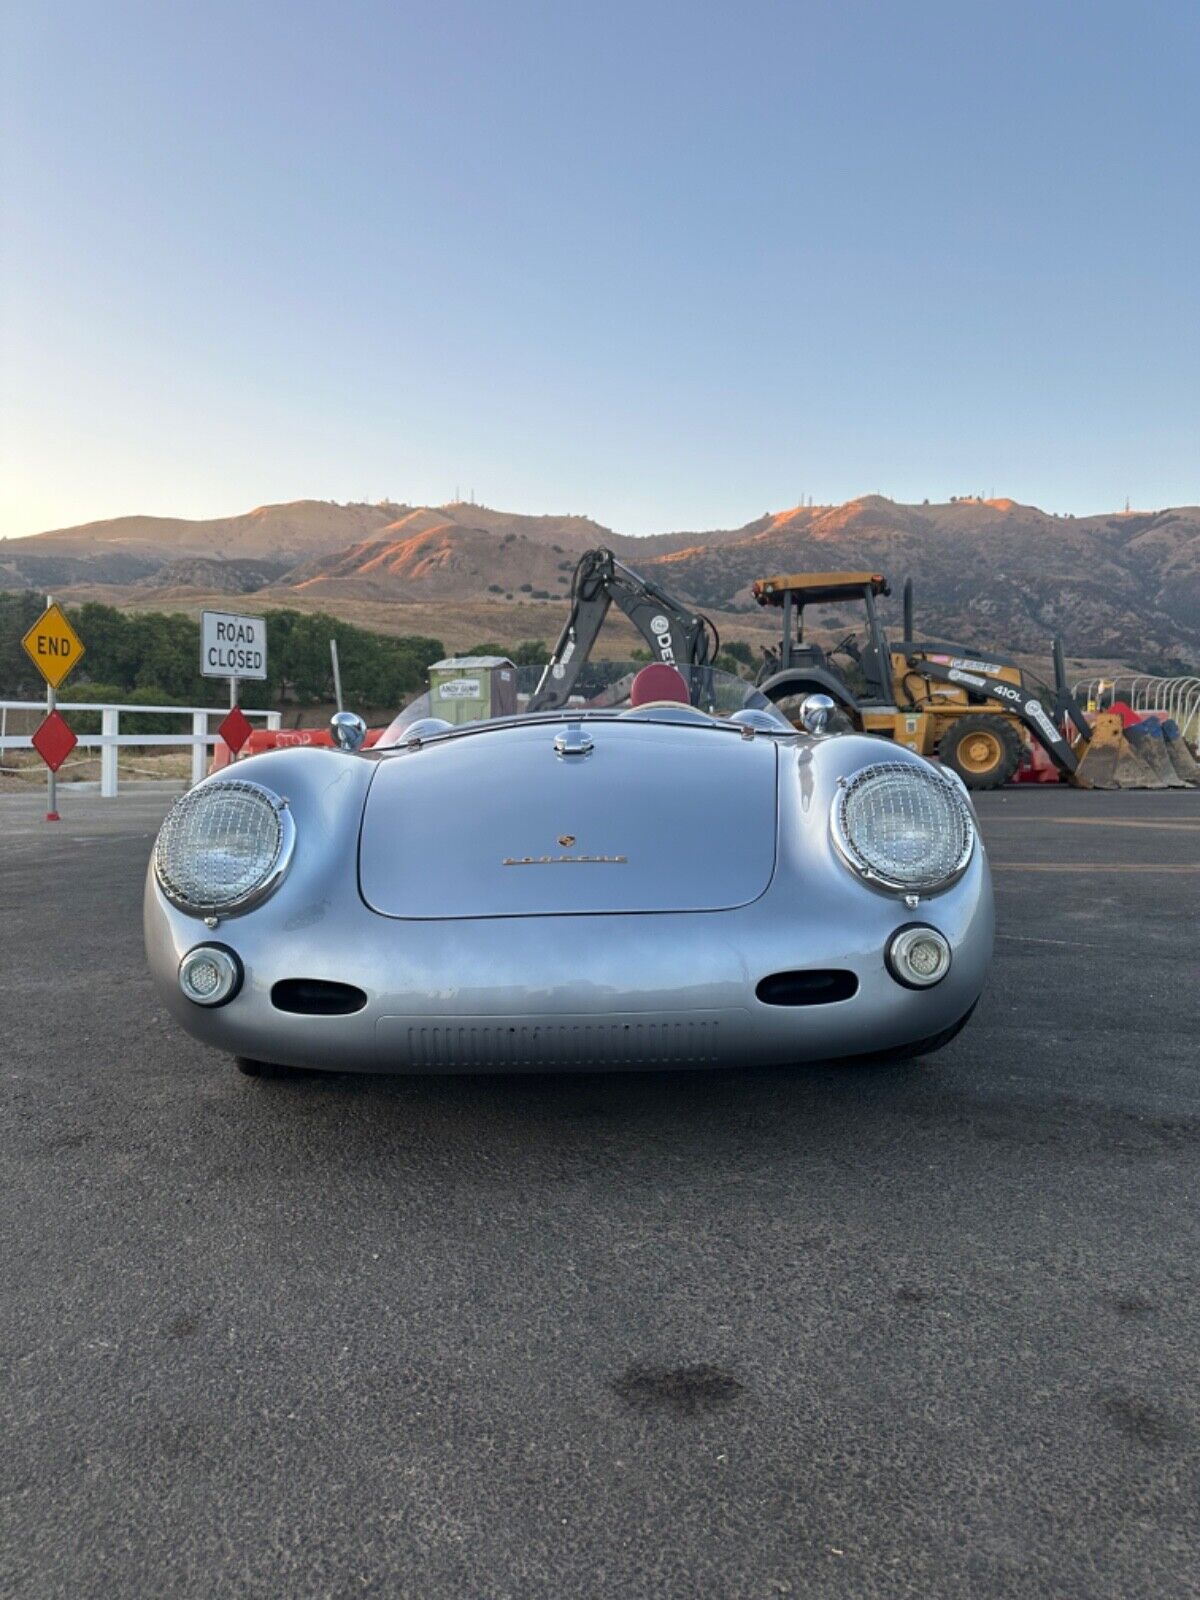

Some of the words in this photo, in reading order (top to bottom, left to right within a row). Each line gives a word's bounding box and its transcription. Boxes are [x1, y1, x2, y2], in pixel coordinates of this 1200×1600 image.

[216, 622, 254, 643] ROAD
[37, 635, 70, 656] END
[207, 647, 261, 669] CLOSED
[993, 685, 1022, 703] 410L
